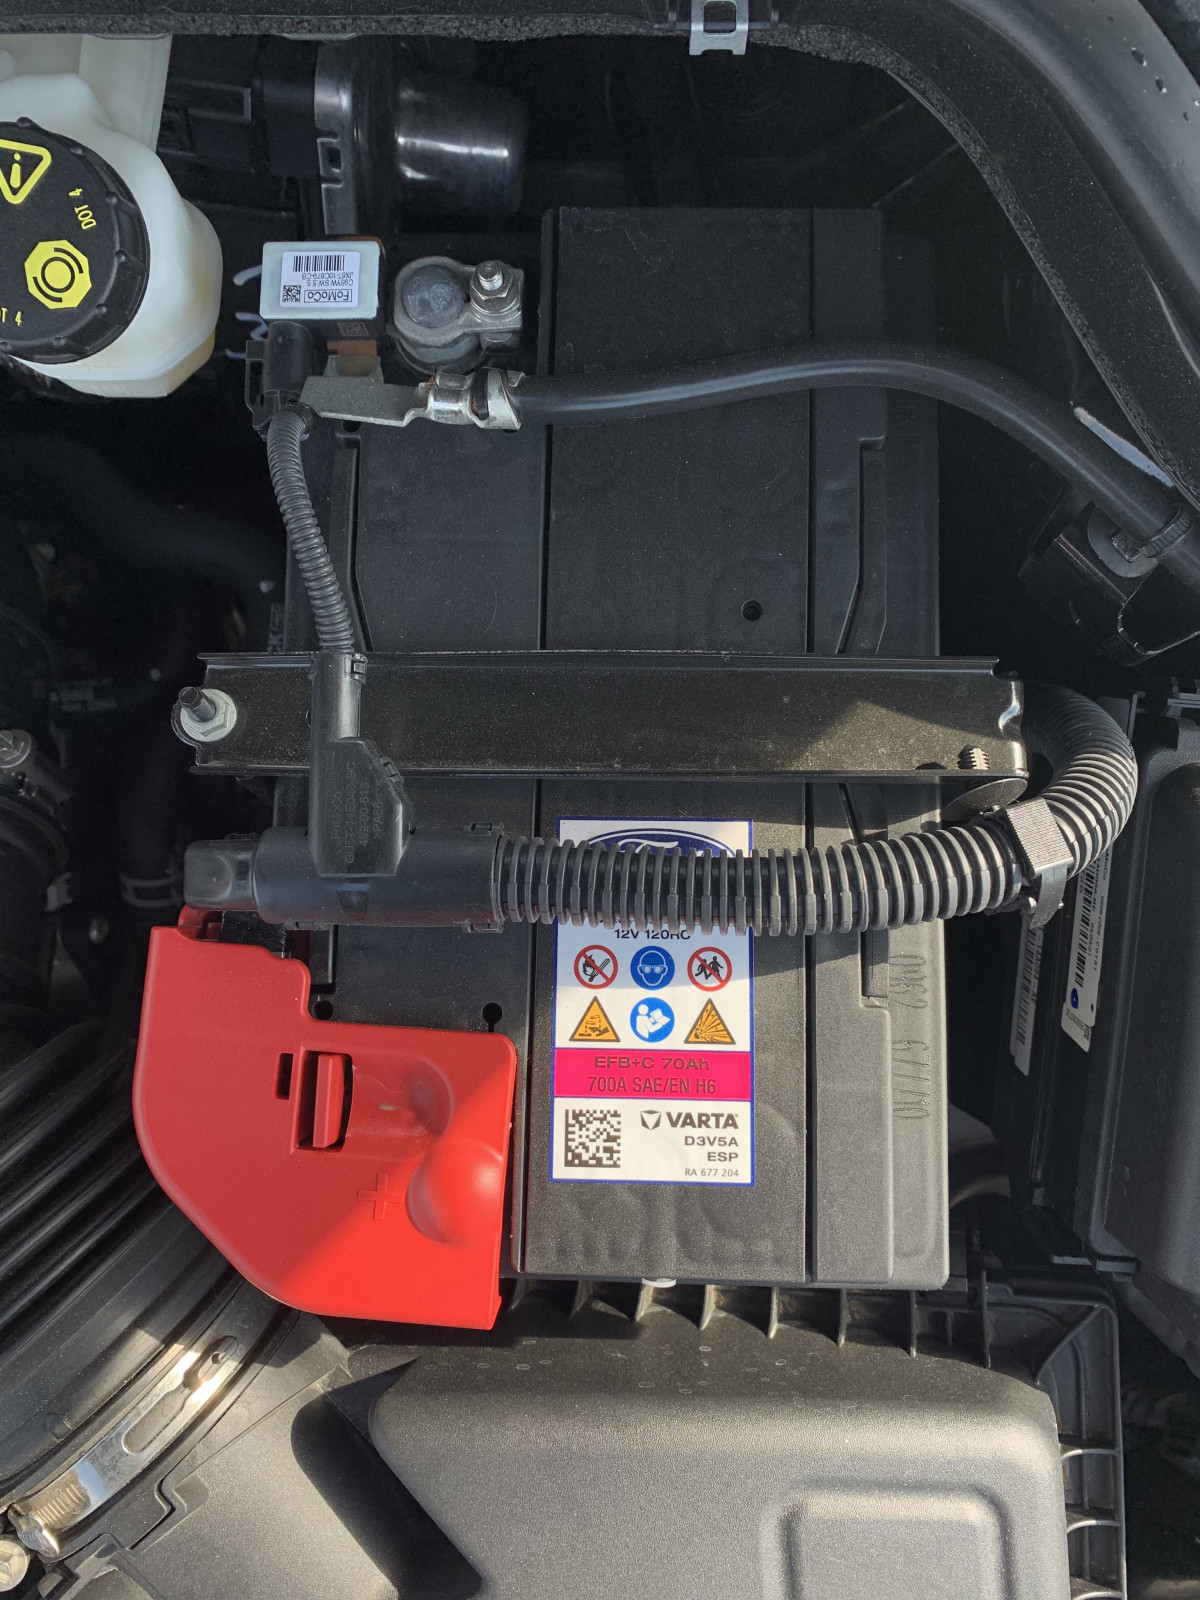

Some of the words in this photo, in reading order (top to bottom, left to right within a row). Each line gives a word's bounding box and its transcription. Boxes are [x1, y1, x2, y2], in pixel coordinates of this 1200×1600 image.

[68, 187, 83, 197] 4
[74, 204, 97, 230] DOT
[307, 290, 350, 302] FoMoCo
[14, 310, 22, 327] 4
[614, 928, 640, 939] 12V
[594, 1055, 656, 1070] EFB+C
[661, 1057, 710, 1071] 70Ah
[587, 1075, 628, 1093] 700A
[632, 1076, 690, 1094] SAE/EN
[695, 1078, 717, 1095] H6
[665, 1111, 740, 1130] VARTA
[684, 1135, 740, 1148] D3V5A
[707, 1151, 739, 1163] ESP
[684, 1167, 698, 1177] RA
[700, 1168, 719, 1178] 677
[721, 1168, 739, 1178] 204
